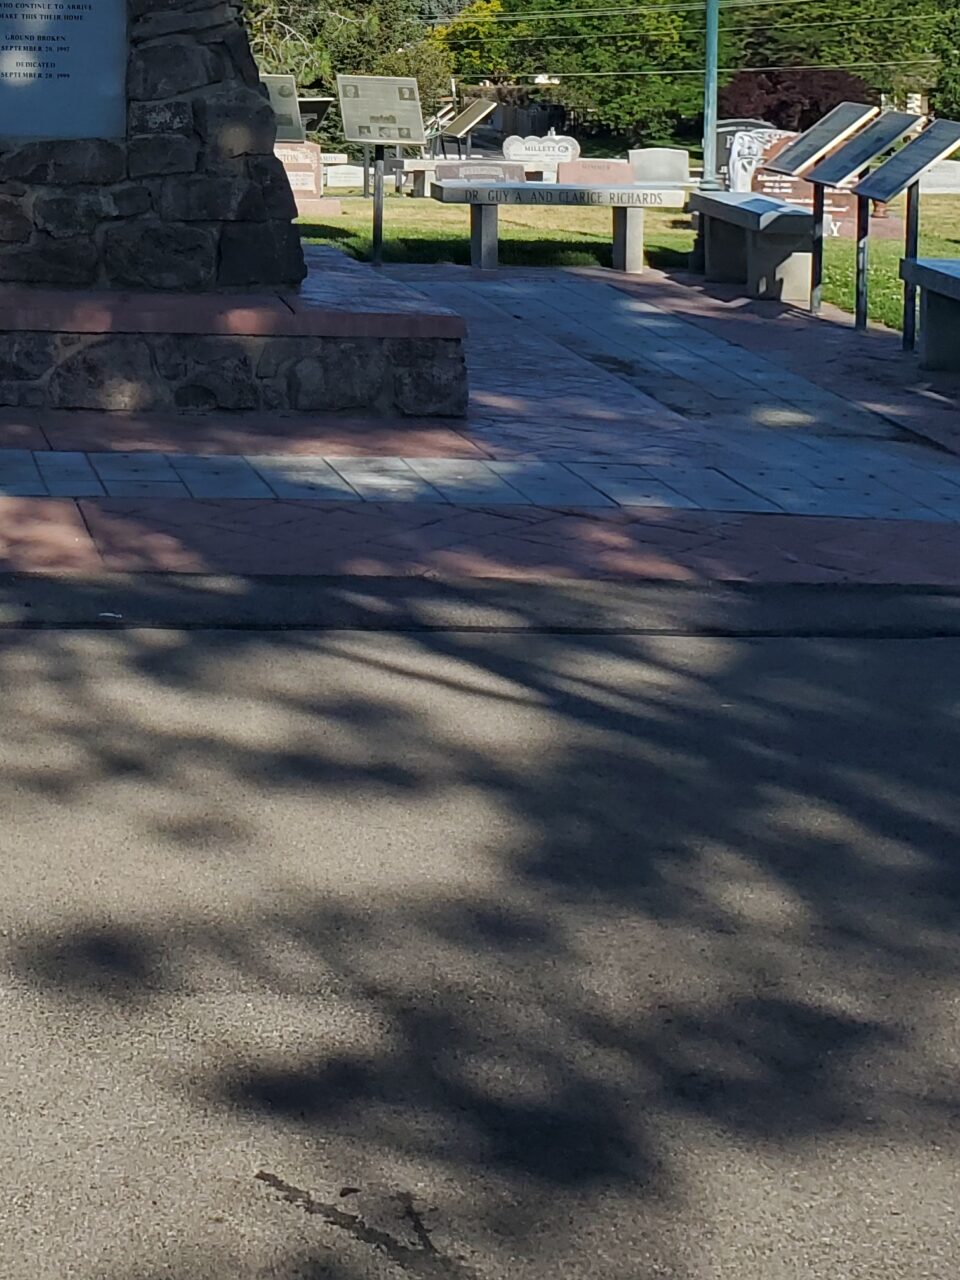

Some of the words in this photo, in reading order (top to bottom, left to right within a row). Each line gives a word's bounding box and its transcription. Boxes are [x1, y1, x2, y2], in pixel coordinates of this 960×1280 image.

[488, 190, 510, 201] GUY
[531, 191, 553, 202] AND
[559, 191, 603, 204] CLARICE
[609, 192, 663, 205] RICHARDS
